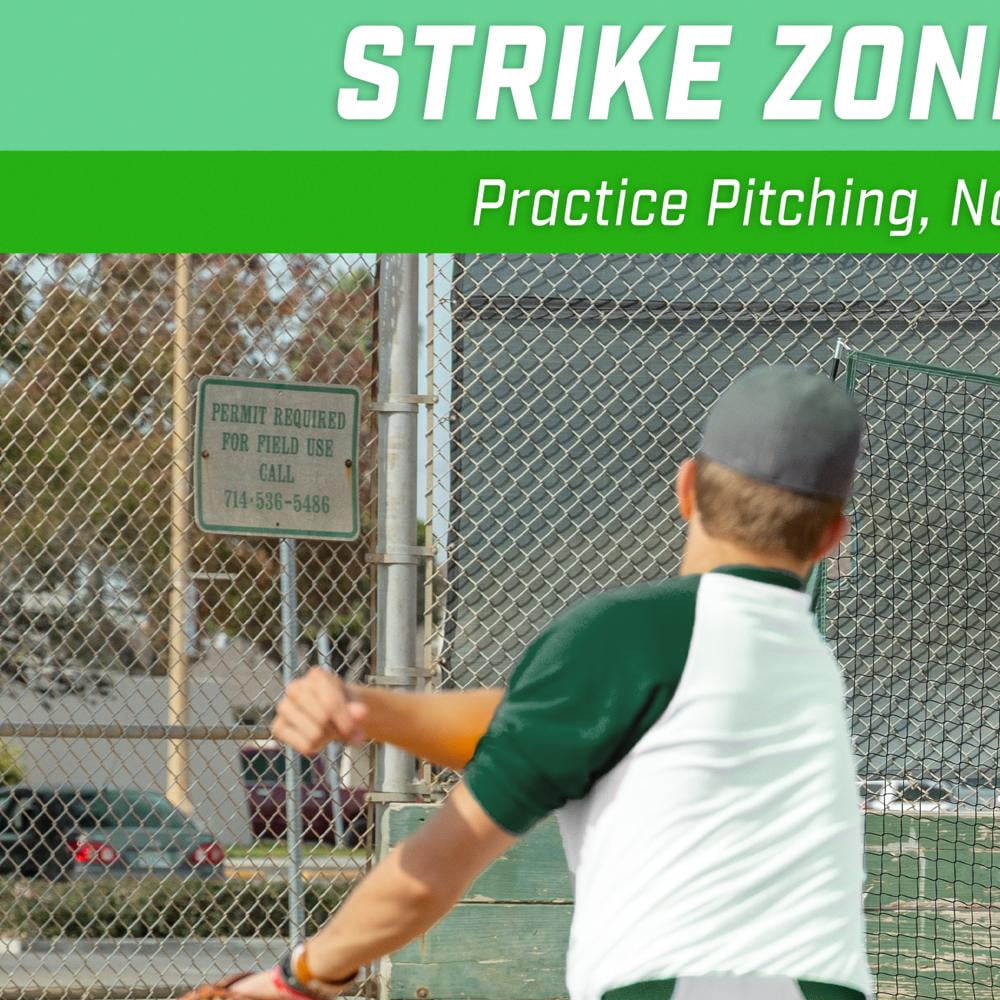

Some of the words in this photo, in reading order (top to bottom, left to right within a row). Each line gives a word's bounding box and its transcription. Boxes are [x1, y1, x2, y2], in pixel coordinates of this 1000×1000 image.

[211, 402, 267, 425] PERMIT
[273, 407, 346, 430] REQUIRED
[222, 431, 249, 452] FOR
[256, 434, 299, 455] FIELD
[306, 438, 334, 458] USE
[259, 463, 295, 484] CALL
